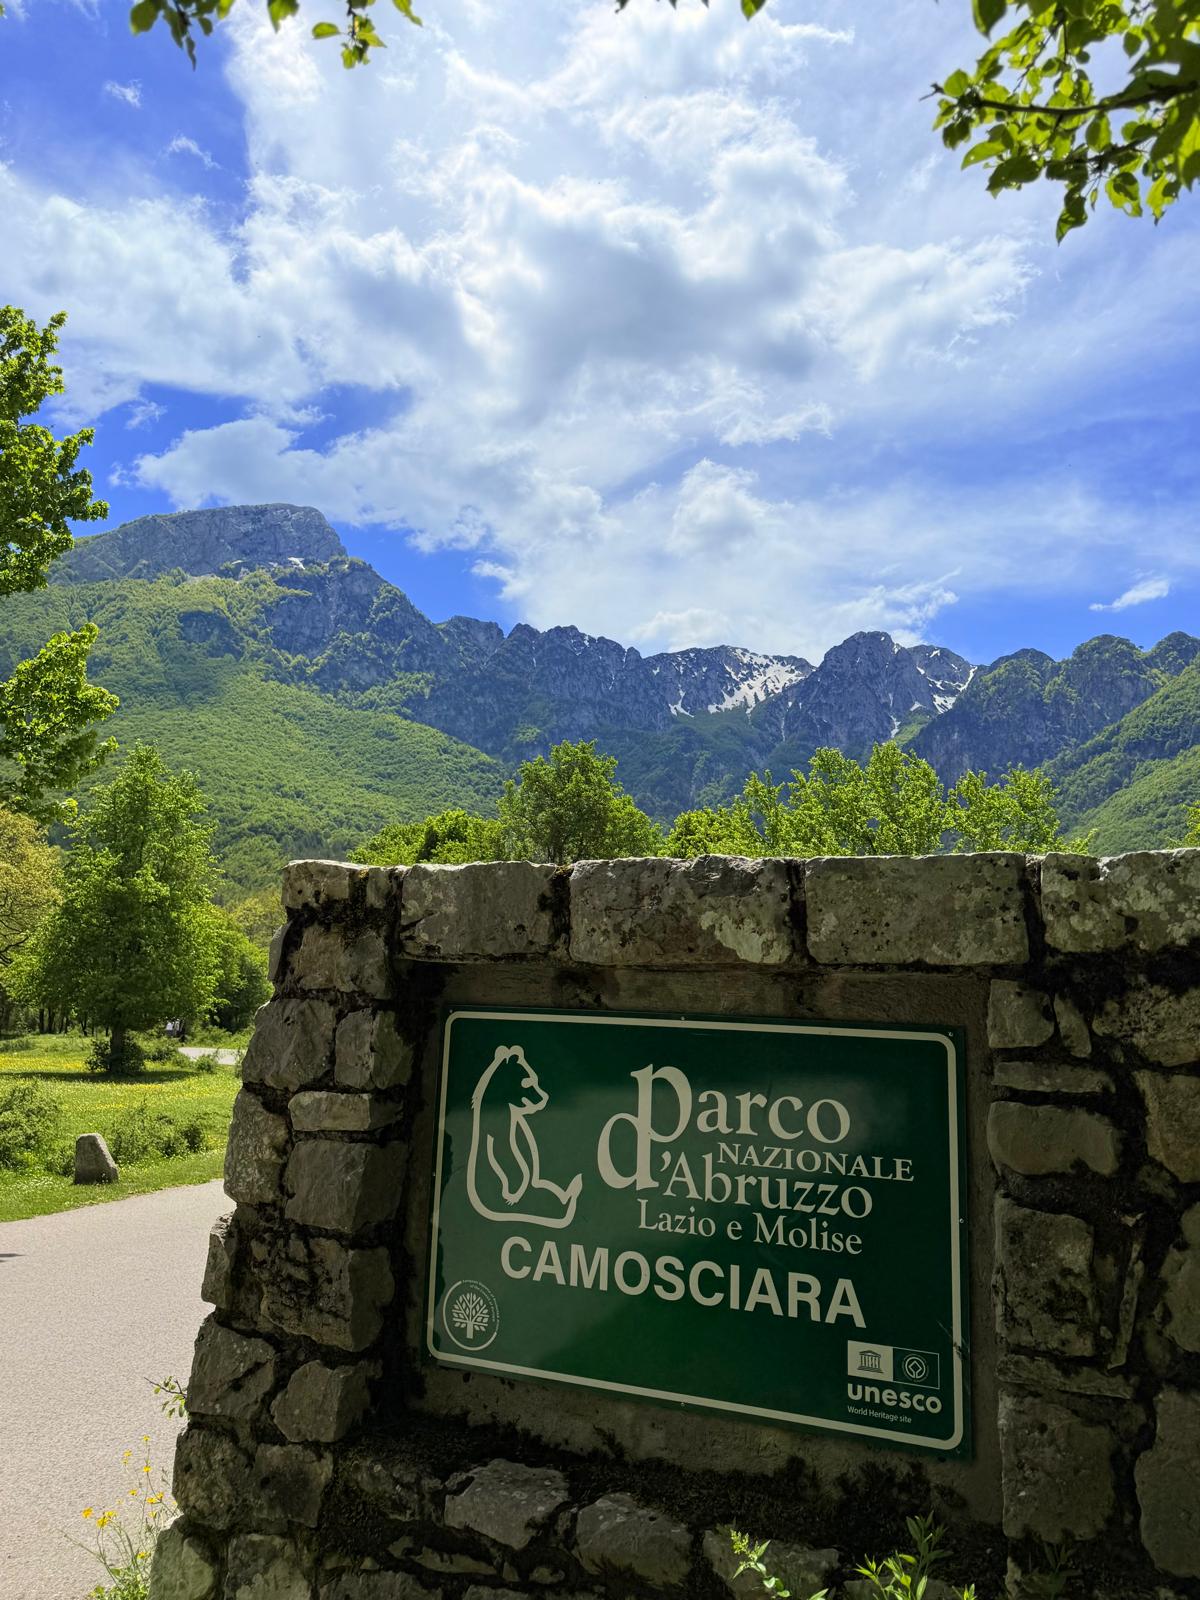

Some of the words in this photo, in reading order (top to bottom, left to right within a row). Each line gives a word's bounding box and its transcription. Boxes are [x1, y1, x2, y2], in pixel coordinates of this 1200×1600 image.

[717, 1141, 914, 1182] NAZIONALE
[637, 1199, 716, 1237] Lazio
[726, 1220, 742, 1240] e
[752, 1212, 863, 1255] Molise
[500, 1235, 867, 1329] CAMOSCIARA
[847, 1383, 942, 1414] unesco
[847, 1405, 868, 1416] World
[869, 1409, 898, 1422] Heritage
[899, 1414, 912, 1424] site
